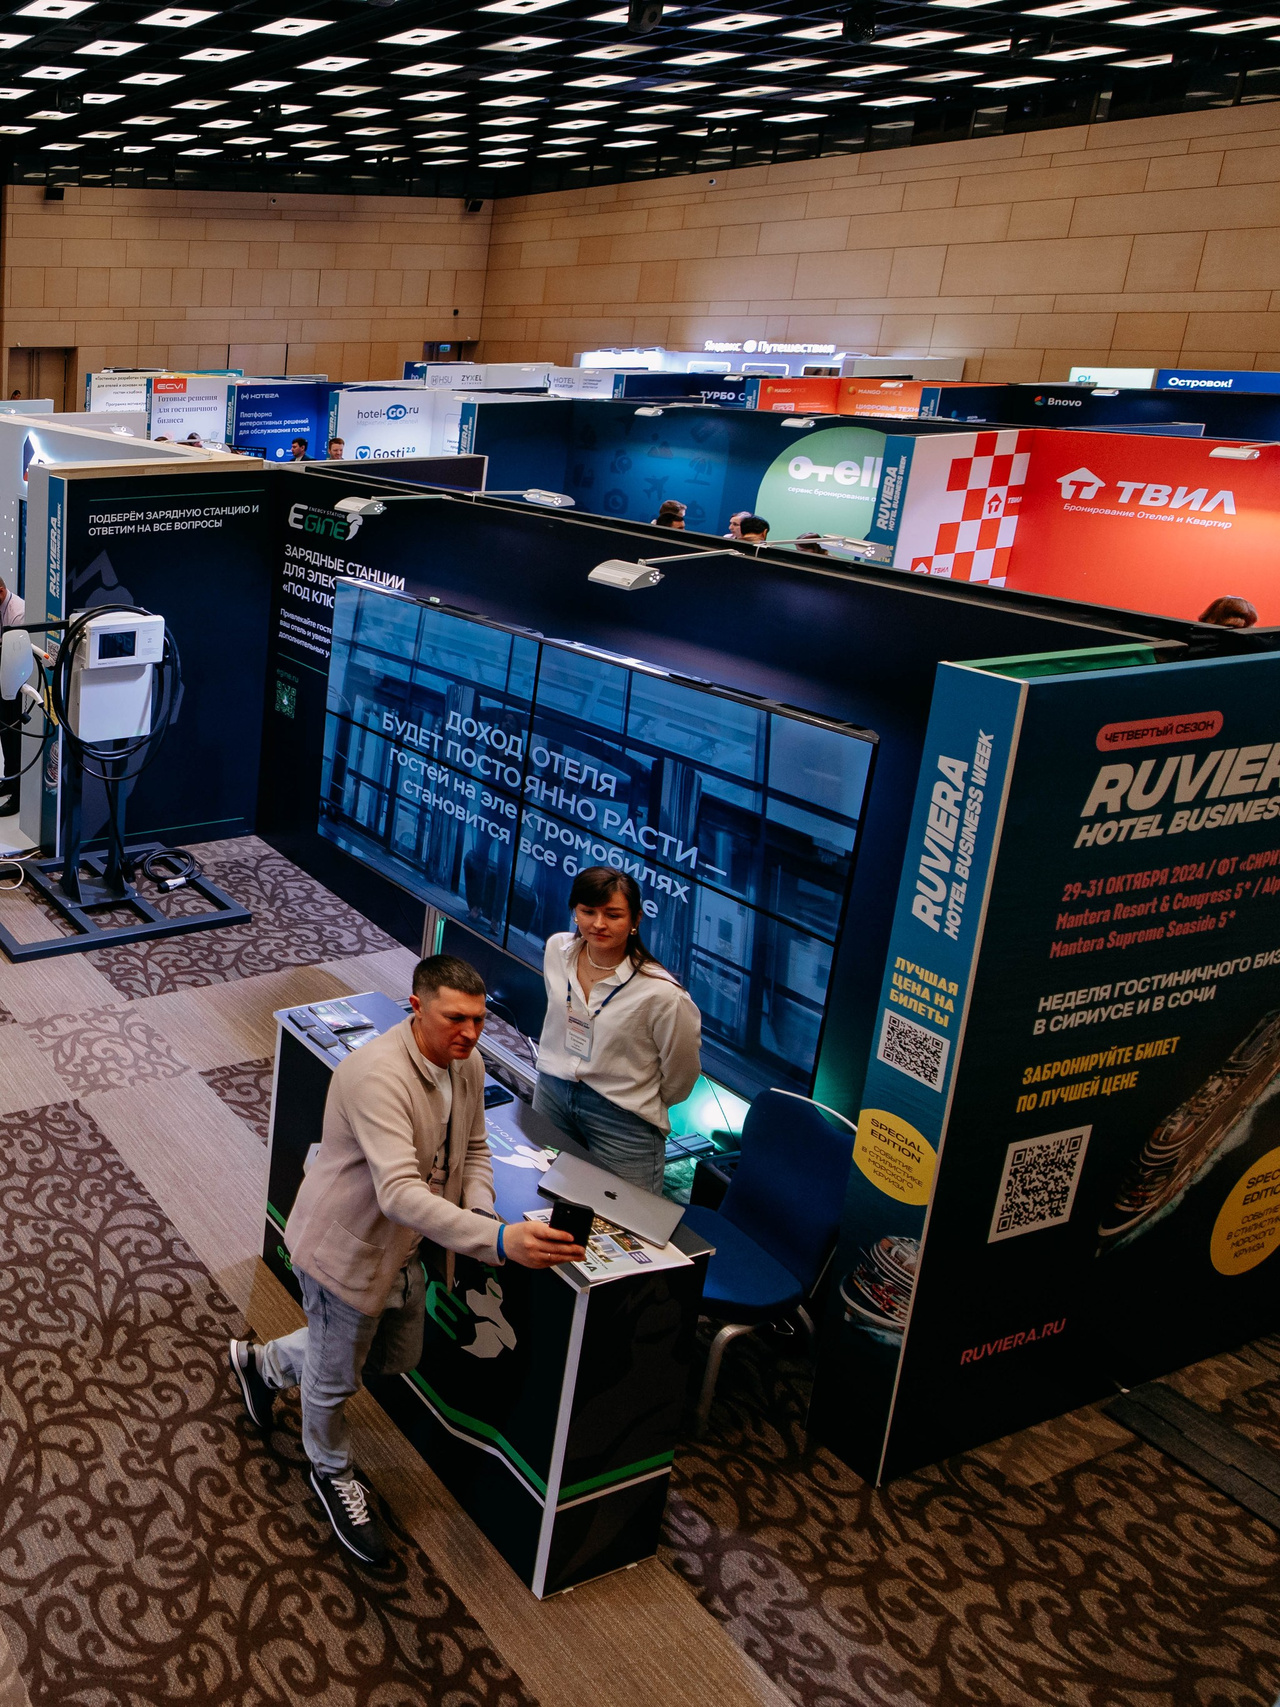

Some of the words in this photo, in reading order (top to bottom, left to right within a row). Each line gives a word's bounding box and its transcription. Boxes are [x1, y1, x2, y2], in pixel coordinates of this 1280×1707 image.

[704, 340, 742, 352] Яндекс
[758, 340, 836, 354] Путешествия
[439, 376, 452, 384] HSU
[700, 390, 735, 400] ТУРБО
[1168, 377, 1233, 388] Островок!
[158, 395, 187, 403] Готовые
[188, 395, 218, 403] решения
[357, 404, 419, 420] hotel-GO.ru
[856, 404, 897, 412] ЦИФРОВЫЕ
[1048, 397, 1082, 407] Bnovo
[157, 416, 184, 424] бизнеса
[374, 447, 405, 458] Gosti
[308, 506, 326, 514] ENERGY
[788, 486, 812, 496] сервис
[814, 489, 869, 502] бронирования
[876, 466, 898, 531] RUVIERA
[1116, 480, 1236, 515] ТВИЛ
[88, 525, 136, 536] ОТВЕТИМ
[137, 524, 151, 533] НА
[153, 522, 173, 532] ВСЕ
[174, 519, 223, 531] ВОПРОСЫ
[89, 510, 144, 524] ПОДБЕРЁМ
[145, 508, 202, 521] ЗАРЯДНУЮ
[203, 505, 250, 517] СТАНЦИЮ
[252, 504, 259, 513] И
[888, 509, 897, 531] HOTEL
[1063, 503, 1135, 518] Бронирование
[1137, 511, 1174, 522] Отелей
[1176, 515, 1184, 523] и
[1186, 516, 1232, 530] Квартир
[49, 516, 57, 597] RUVIERA
[283, 562, 305, 580] ДЛЯ
[285, 544, 345, 573] ЗАРЯДНЫЕ
[346, 562, 405, 591] СТАНЦИИ
[282, 582, 310, 602] «ПОД
[280, 608, 316, 628] Привлекайте
[280, 620, 290, 629] ваш
[291, 624, 306, 636] отель
[278, 631, 325, 655] дополнительных
[1105, 723, 1174, 744] ЧЕТВЕРТЫЙ
[1175, 720, 1215, 735] СЕЗОН
[445, 709, 523, 762] ДОХОД
[531, 745, 618, 798] ОТЕЛЯ
[971, 729, 995, 786] WEEK
[382, 711, 444, 754] БУДЕТ
[445, 739, 597, 822] ПОСТОЯННО
[602, 808, 698, 869] РАСТИ
[389, 748, 450, 787] гостей
[453, 778, 476, 801] на
[481, 790, 690, 904] электромобилях
[402, 780, 511, 845] становится
[519, 836, 557, 867] все
[954, 786, 984, 881] BUSINESS
[1073, 814, 1165, 849] HOTEL
[912, 755, 969, 933] RUVIERA
[1062, 877, 1104, 902] 29-31
[1106, 868, 1170, 895] ОКТЯБРЯ
[1170, 862, 1206, 884] 2024
[1218, 856, 1239, 876] ФТ
[944, 881, 968, 941] HOTEL
[1056, 908, 1110, 931] Mantera
[1113, 899, 1157, 921] Resort
[1160, 897, 1170, 913] &
[1173, 886, 1232, 911] Congress
[1049, 937, 1104, 959] Mantera
[1107, 924, 1164, 949] Supreme
[1166, 914, 1216, 938] Seaside
[892, 972, 930, 1002] ЦЕНА
[934, 991, 955, 1013] НА
[894, 957, 959, 997] ЛУЧШАЯ
[1038, 984, 1112, 1013] НЕДЕЛЯ
[1114, 956, 1252, 998] ГОСТИНИЧНОГО
[889, 988, 949, 1028] БИЛЕТЫ
[1033, 1019, 1046, 1036] В
[1049, 1003, 1134, 1033] СИРИУСЕ
[1137, 998, 1151, 1015] И
[1152, 996, 1164, 1011] В
[1167, 985, 1217, 1009] СОЧИ
[1022, 1046, 1134, 1085] ЗАБРОНИРУЙТЕ
[1134, 1036, 1180, 1062] БИЛЕТ
[1016, 1093, 1037, 1113] ПО
[1039, 1076, 1100, 1108] ЛУЧШЕЙ
[1101, 1071, 1140, 1096] ЦЕНЕ
[870, 1117, 924, 1155] SPECIAL
[870, 1128, 921, 1164] EDITION
[861, 1145, 868, 1153] В
[868, 1149, 923, 1188] СТИЛИСТИКЕ
[868, 1157, 913, 1190] МОРСКОГО
[873, 1145, 913, 1173] СОБЫТИЕ
[873, 1168, 906, 1193] КРУИЗА
[960, 1318, 1066, 1365] RUVIERA.RU
